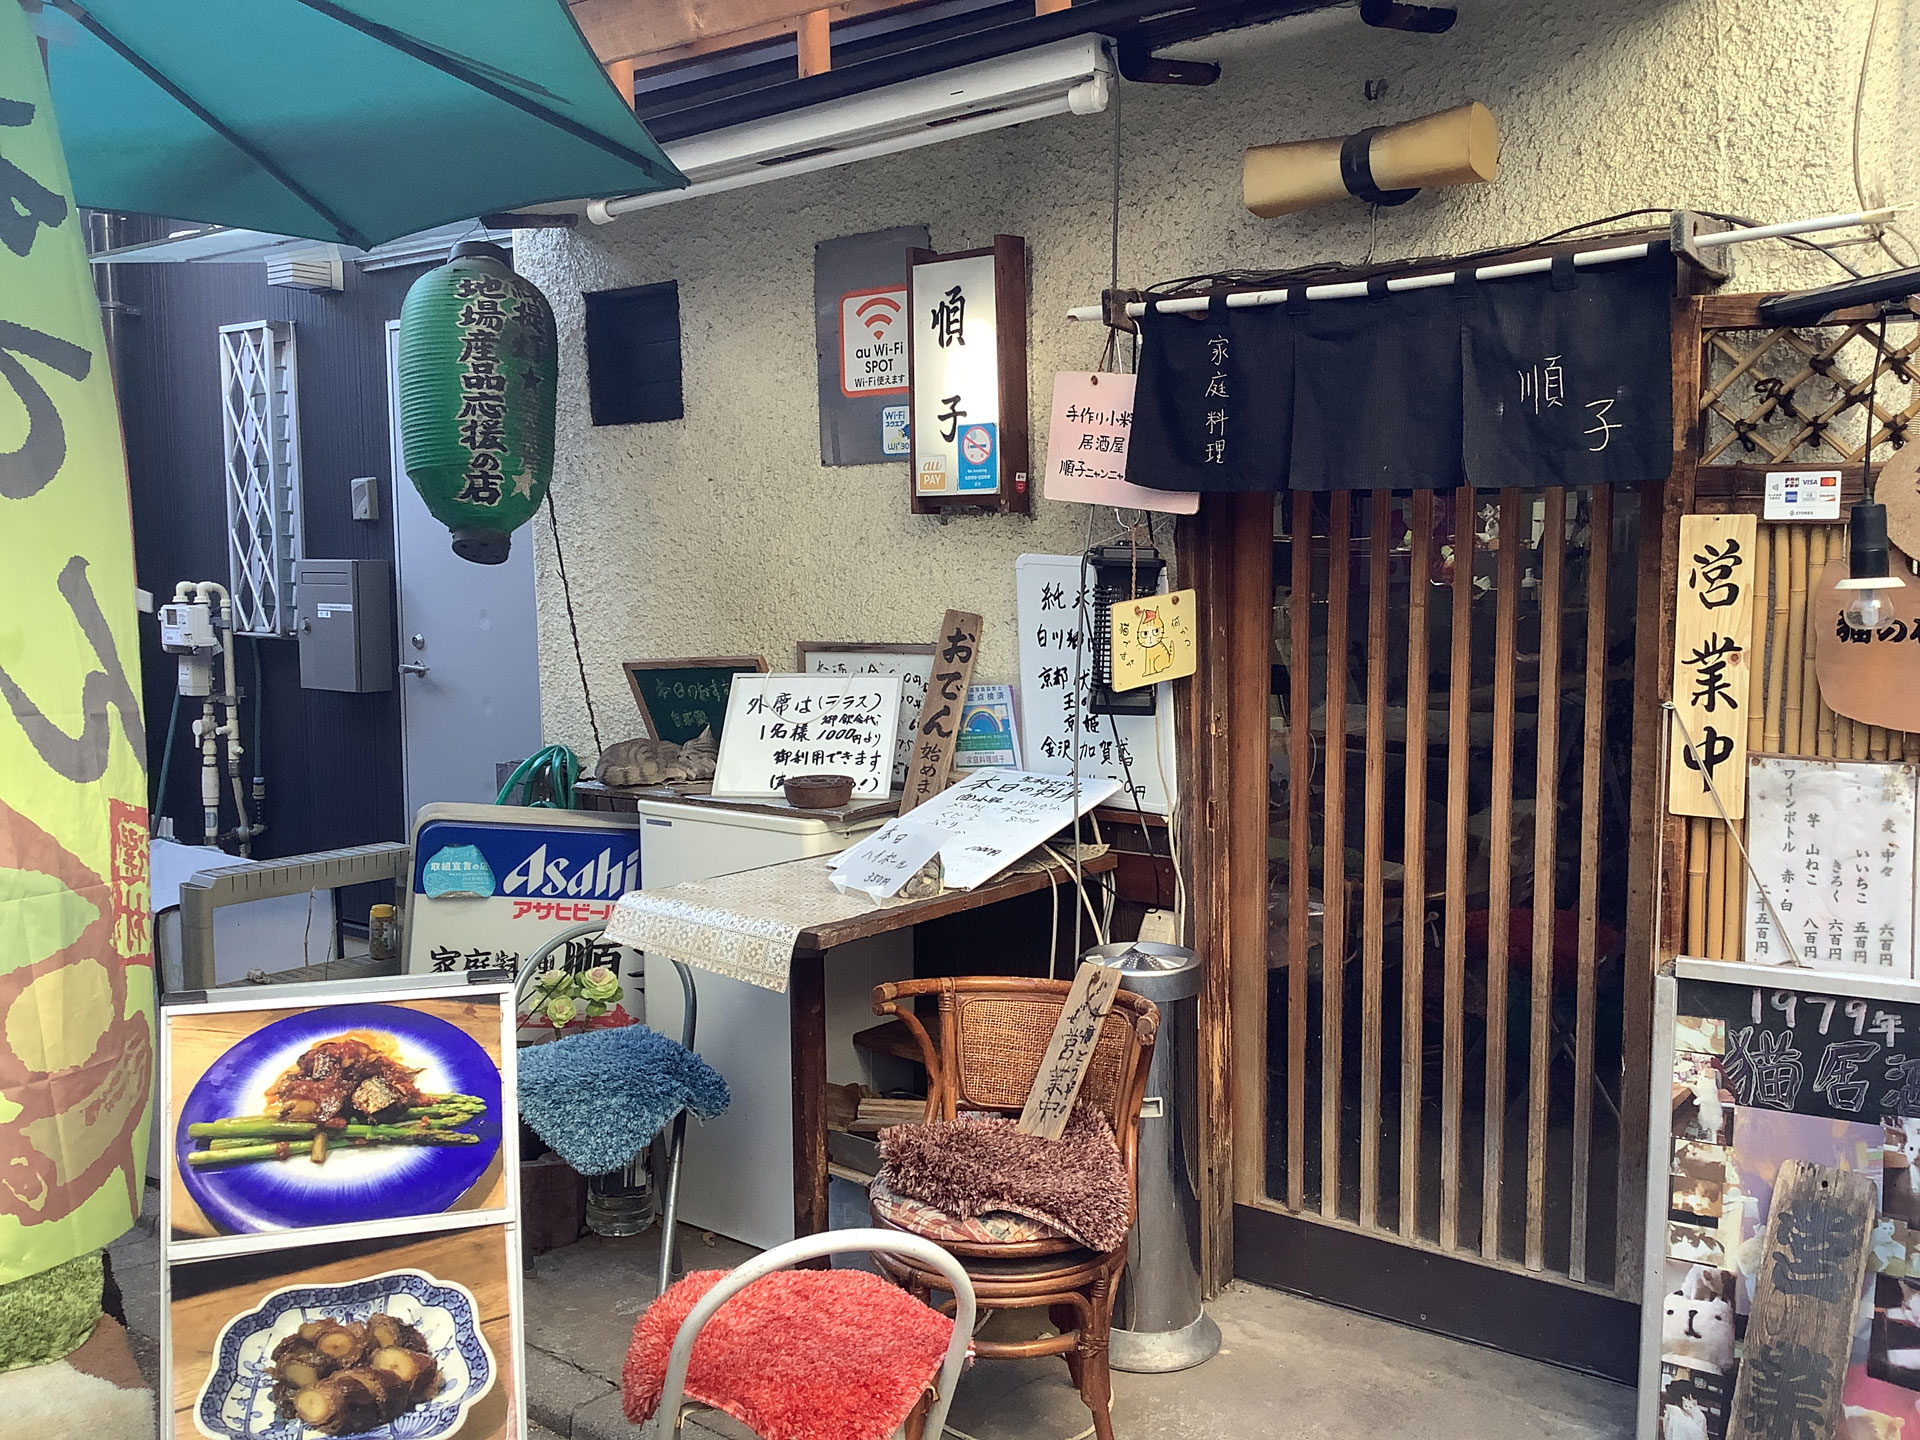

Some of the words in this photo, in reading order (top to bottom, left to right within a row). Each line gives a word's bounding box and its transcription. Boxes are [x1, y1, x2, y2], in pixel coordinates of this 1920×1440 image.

[856, 348, 871, 359] au
[874, 341, 903, 356] Wi-Fi
[865, 359, 893, 373] SPOT
[930, 285, 967, 443] 順子
[456, 275, 508, 504] 地場産品応援の店
[855, 374, 905, 388] Wi-Fi使えます
[1205, 334, 1230, 464] 家庭料理
[885, 411, 905, 420] Wi-Fi
[1518, 354, 1622, 452] 順子
[1078, 433, 1125, 454] 居酒屋
[923, 461, 942, 471] au
[924, 474, 941, 485] PAY
[1059, 459, 1124, 480] 順子ニャンニャ
[1681, 539, 1744, 794] 営業中
[1782, 769, 1797, 853] ワインボトル
[1807, 813, 1821, 828] 芋
[503, 843, 640, 898] Asahi
[861, 849, 908, 870] ハイボール
[863, 871, 892, 886] 350円
[1805, 844, 1820, 886] 山ねこ
[1855, 849, 1870, 904] いいちこ
[1880, 848, 1896, 877] 中々
[1830, 860, 1843, 903] きろく
[1803, 918, 1819, 959] 八百円
[1828, 919, 1844, 961] 六百円
[1853, 922, 1869, 964] 五百円
[1879, 924, 1895, 967] 六百円
